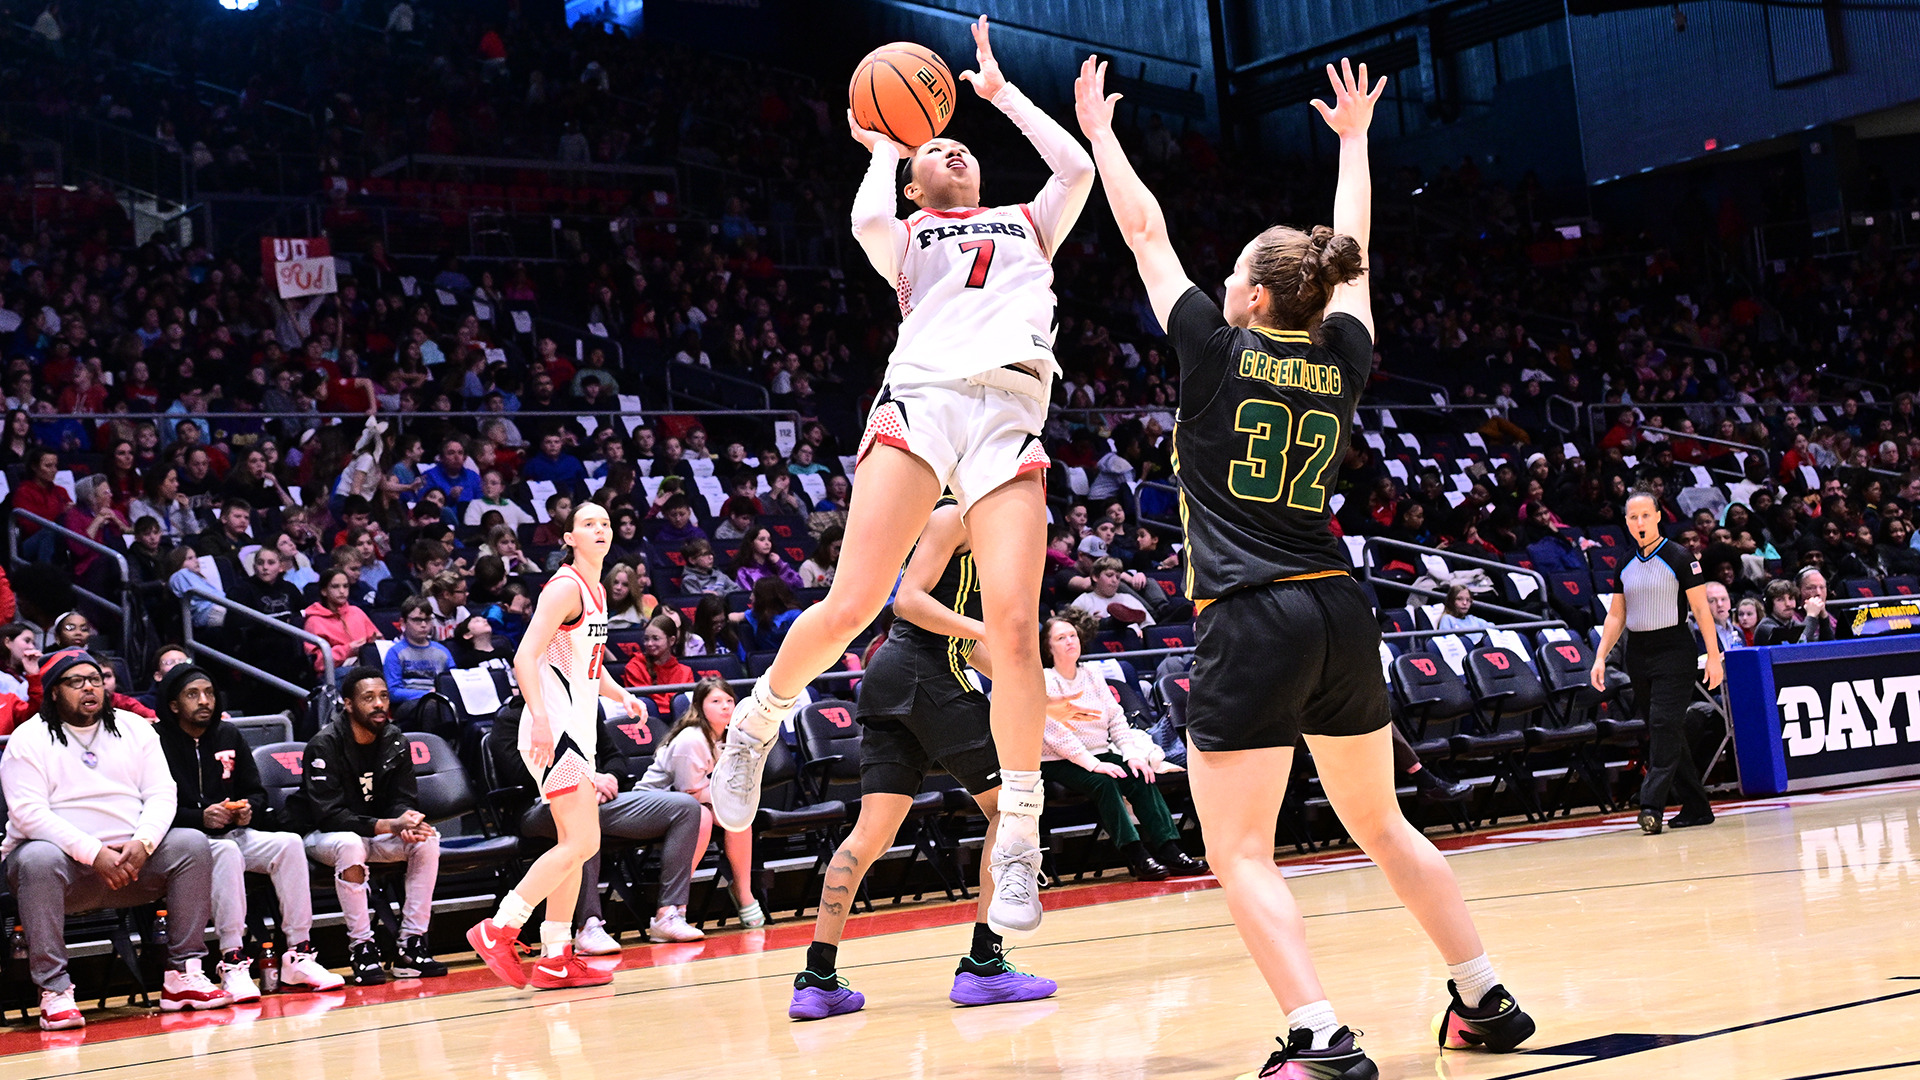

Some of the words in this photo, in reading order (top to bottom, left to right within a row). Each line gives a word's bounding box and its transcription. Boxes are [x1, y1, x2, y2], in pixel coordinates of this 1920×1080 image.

[914, 66, 952, 120] ELITE
[916, 223, 1026, 250] FLYERS
[959, 239, 995, 289] 7
[1238, 349, 1342, 395] GREENURG
[779, 429, 792, 437] 112
[1227, 398, 1341, 513] 32
